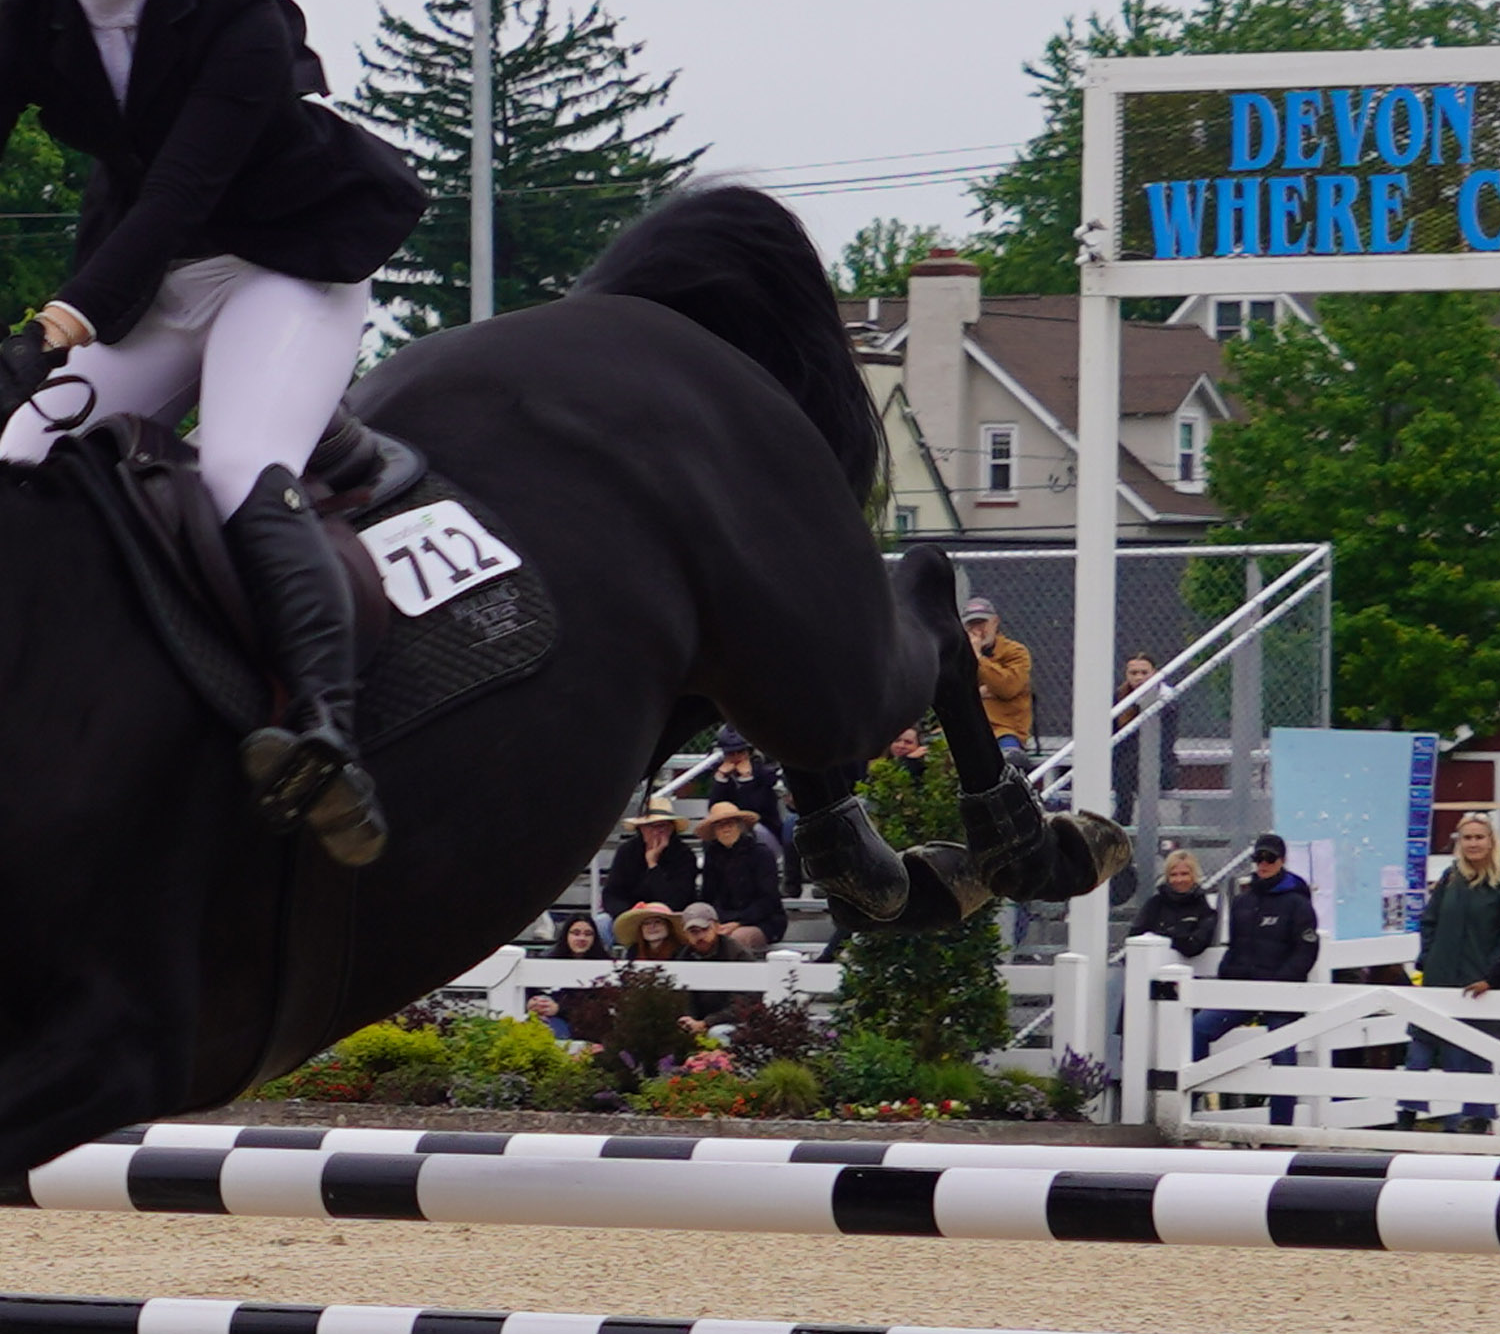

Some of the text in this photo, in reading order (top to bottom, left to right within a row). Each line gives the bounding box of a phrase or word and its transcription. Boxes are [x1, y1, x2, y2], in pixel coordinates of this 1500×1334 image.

[1227, 85, 1475, 171] DEVON
[1146, 173, 1412, 259] WHERE
[384, 527, 502, 601] 712
